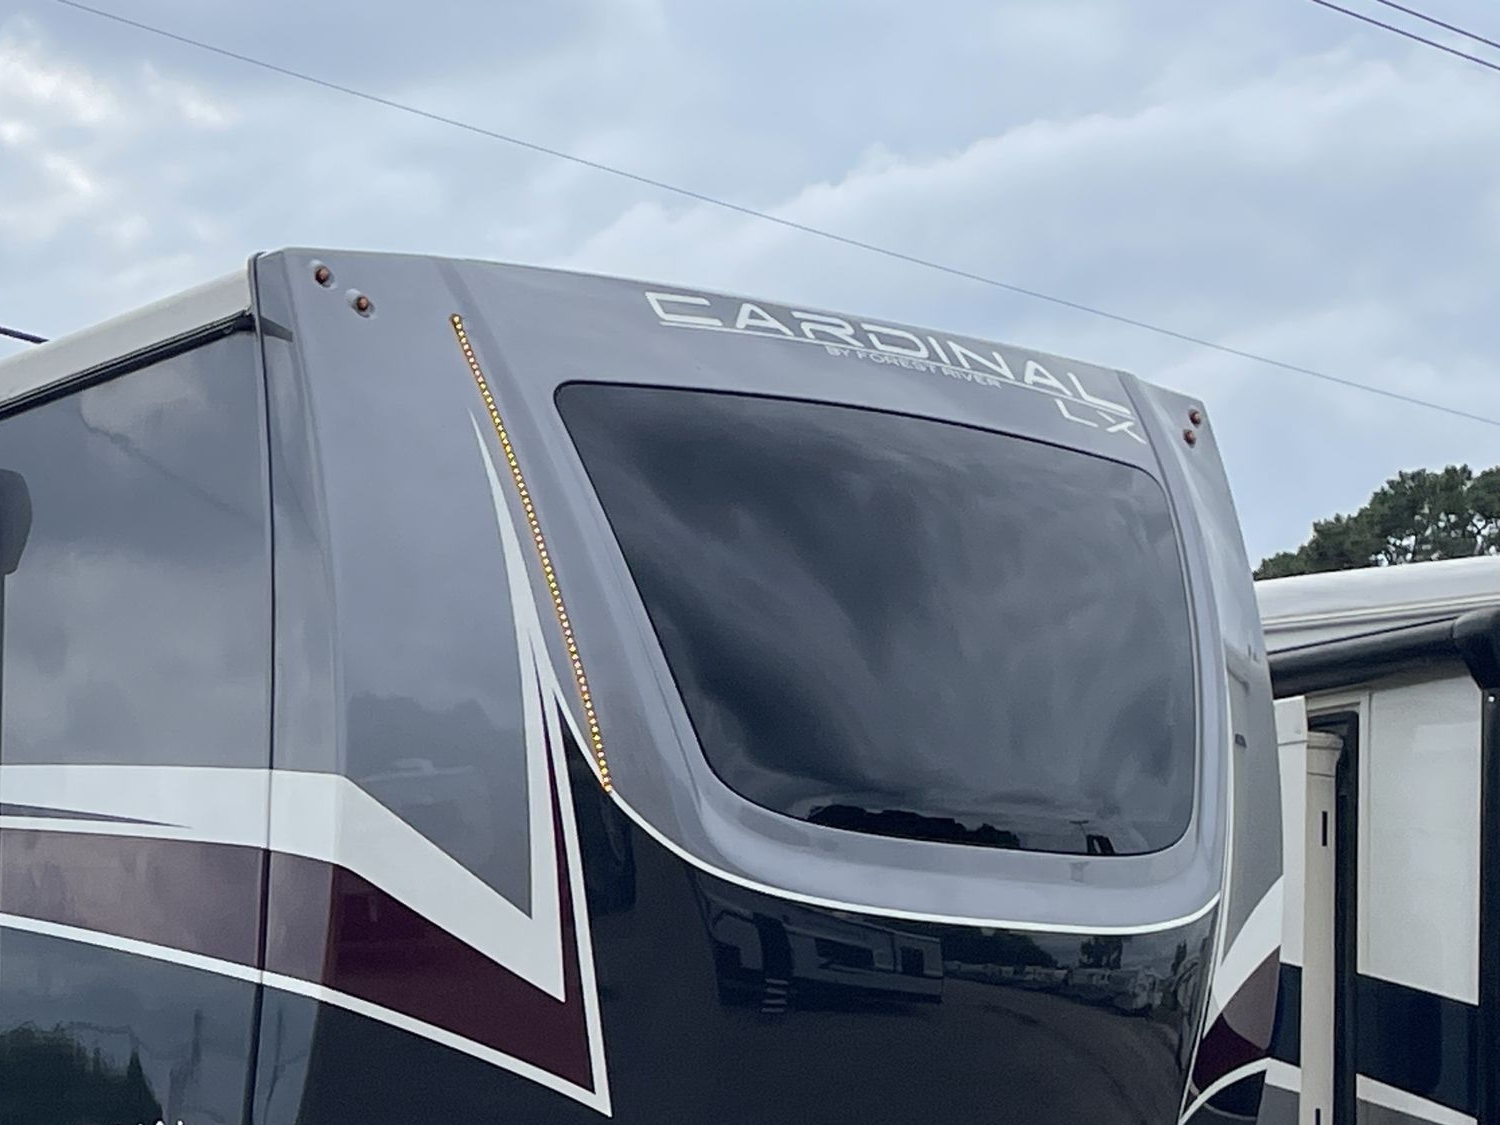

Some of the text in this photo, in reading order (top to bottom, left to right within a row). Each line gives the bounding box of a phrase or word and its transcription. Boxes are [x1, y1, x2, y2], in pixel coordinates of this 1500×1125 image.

[645, 292, 1131, 415] CARDINAL
[825, 345, 1002, 389] BY FOREST RIVER
[1054, 398, 1147, 444] LX
